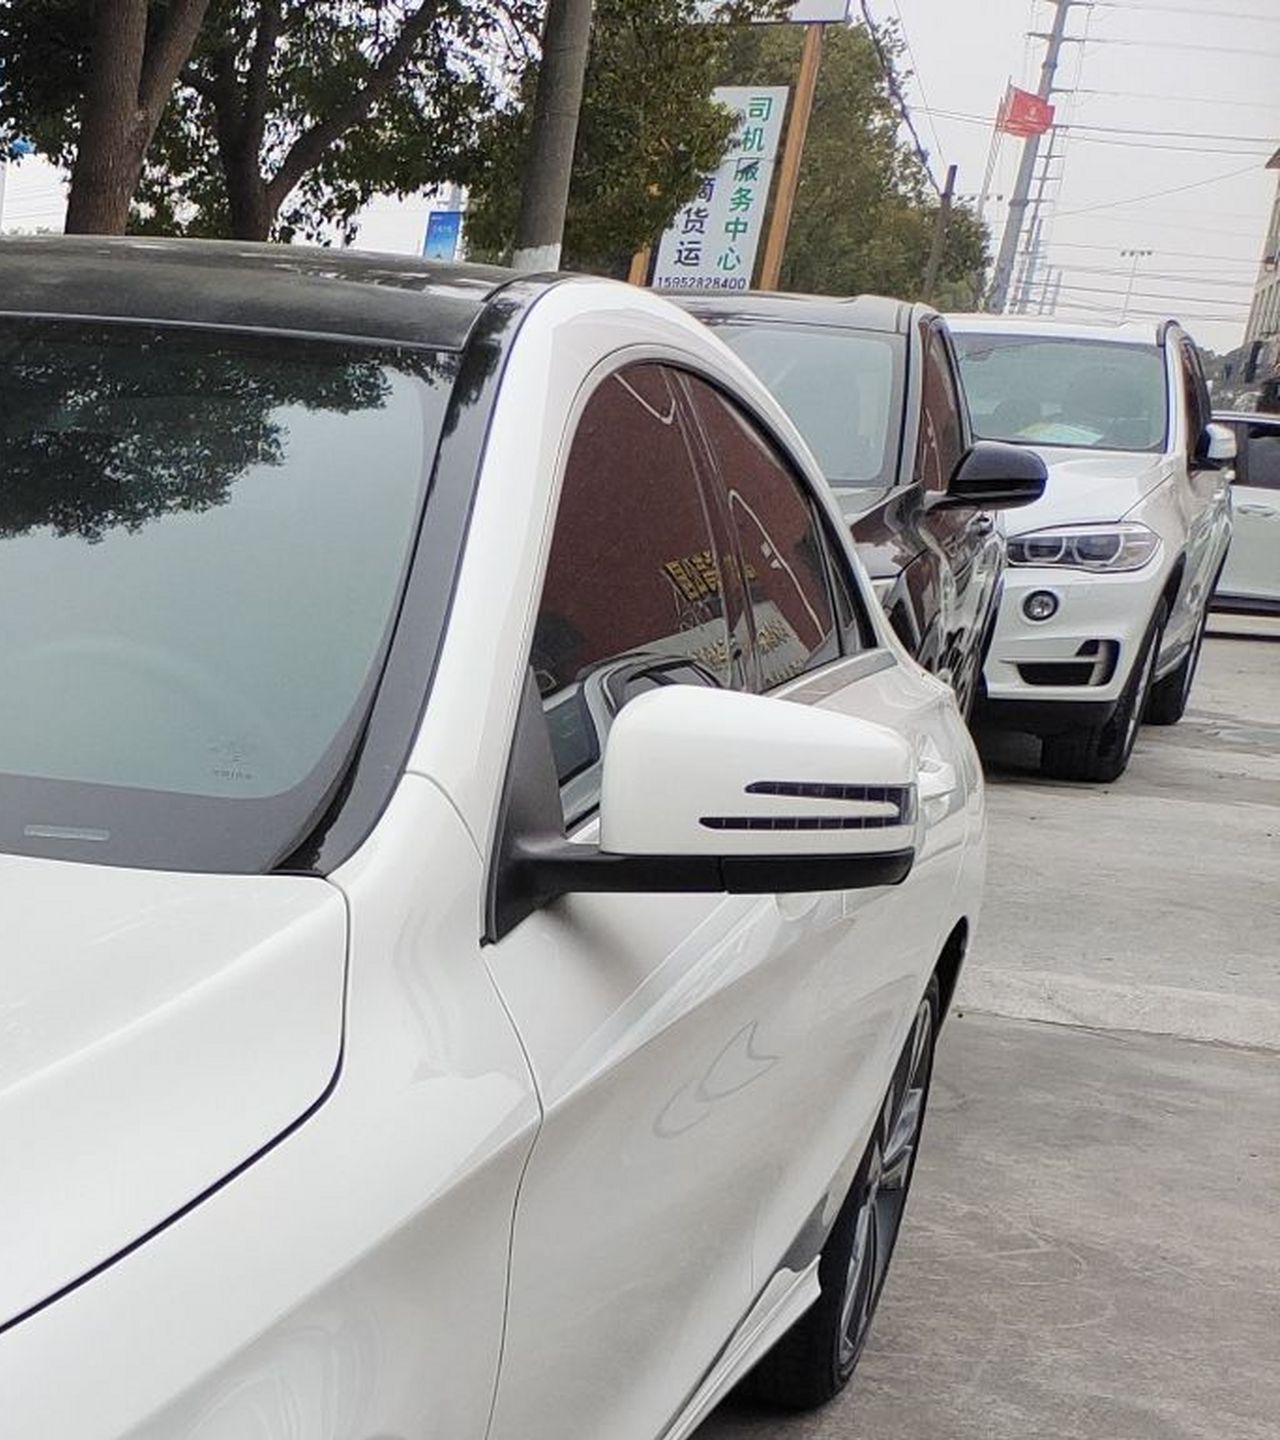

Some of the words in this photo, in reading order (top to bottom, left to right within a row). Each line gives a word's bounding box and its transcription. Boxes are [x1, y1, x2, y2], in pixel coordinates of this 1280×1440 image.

[717, 97, 772, 271] 司机服务中心
